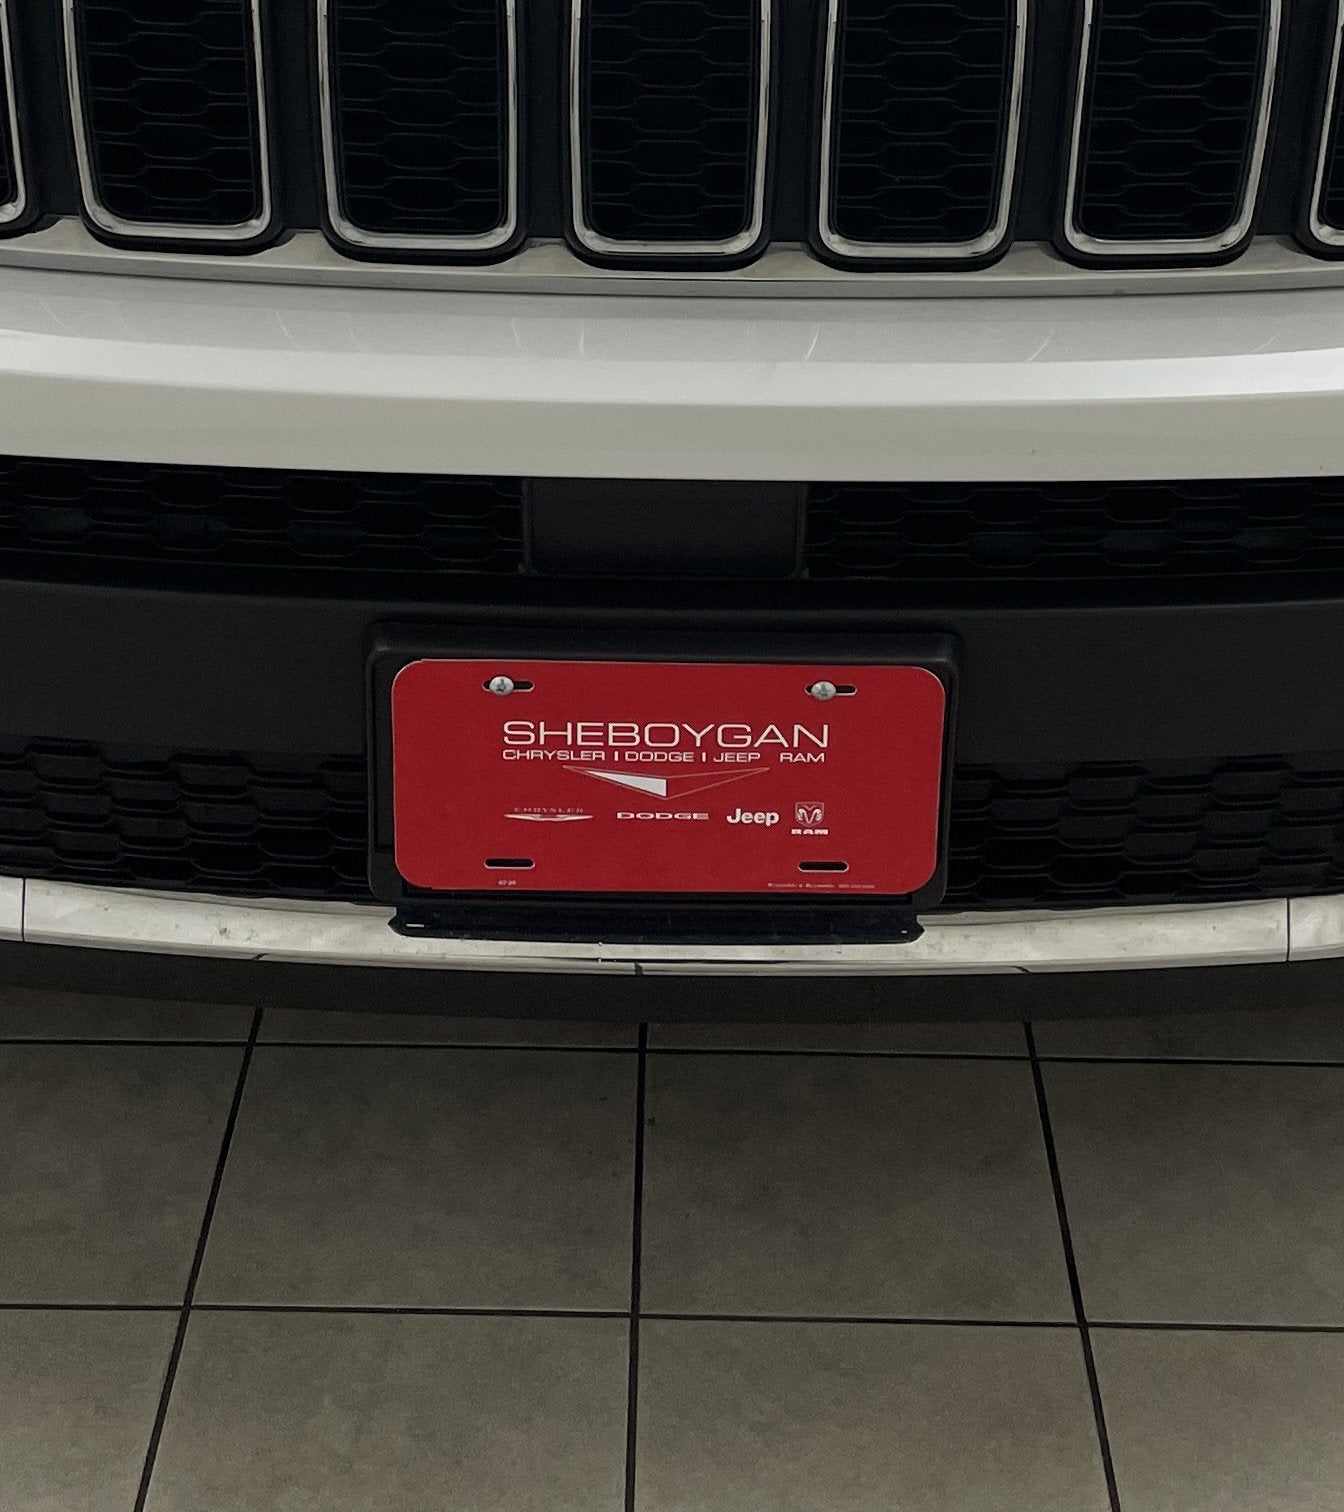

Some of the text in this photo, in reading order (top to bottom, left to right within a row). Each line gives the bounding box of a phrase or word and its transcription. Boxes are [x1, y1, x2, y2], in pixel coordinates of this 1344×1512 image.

[503, 720, 829, 748] SHEBOYGAN
[502, 749, 606, 761] CHRYSLER
[624, 751, 695, 762] DODGE
[712, 752, 761, 763] JEEP
[779, 752, 825, 763] RAM
[616, 811, 710, 821] DODGE
[726, 808, 780, 827] Jeep
